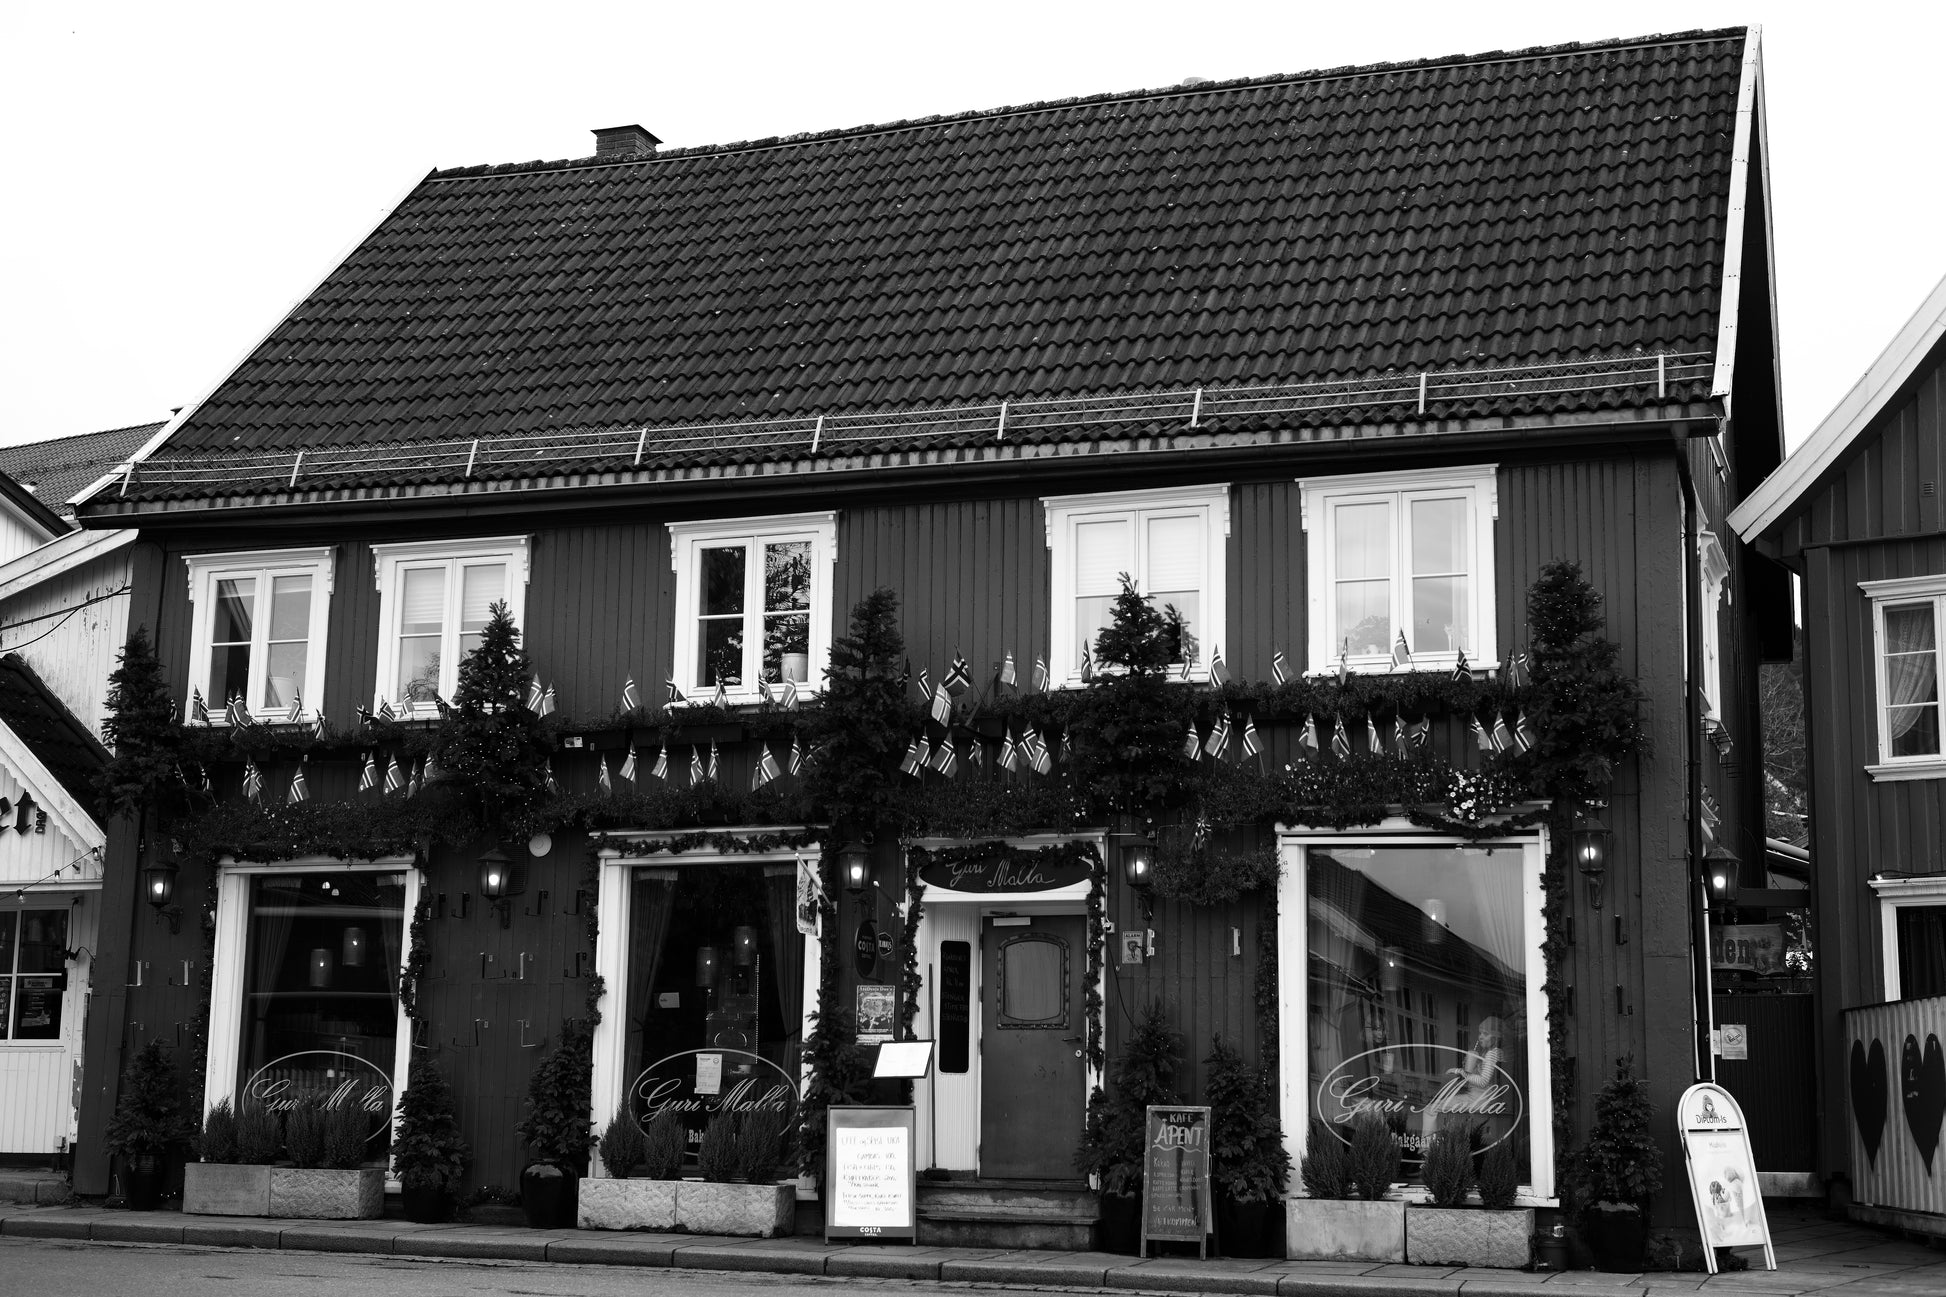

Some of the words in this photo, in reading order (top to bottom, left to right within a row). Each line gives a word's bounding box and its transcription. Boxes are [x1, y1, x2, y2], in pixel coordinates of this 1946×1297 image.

[945, 860, 987, 887] Guri
[858, 940, 875, 953] COSTA
[317, 1079, 387, 1112] Mlla
[638, 1077, 704, 1122] Guri
[705, 1078, 789, 1113] Malla
[1329, 1075, 1407, 1123] Guri
[1410, 1076, 1509, 1115] Malla
[1154, 1118, 1205, 1146] ÅPENT
[1169, 1113, 1193, 1123] KAFE
